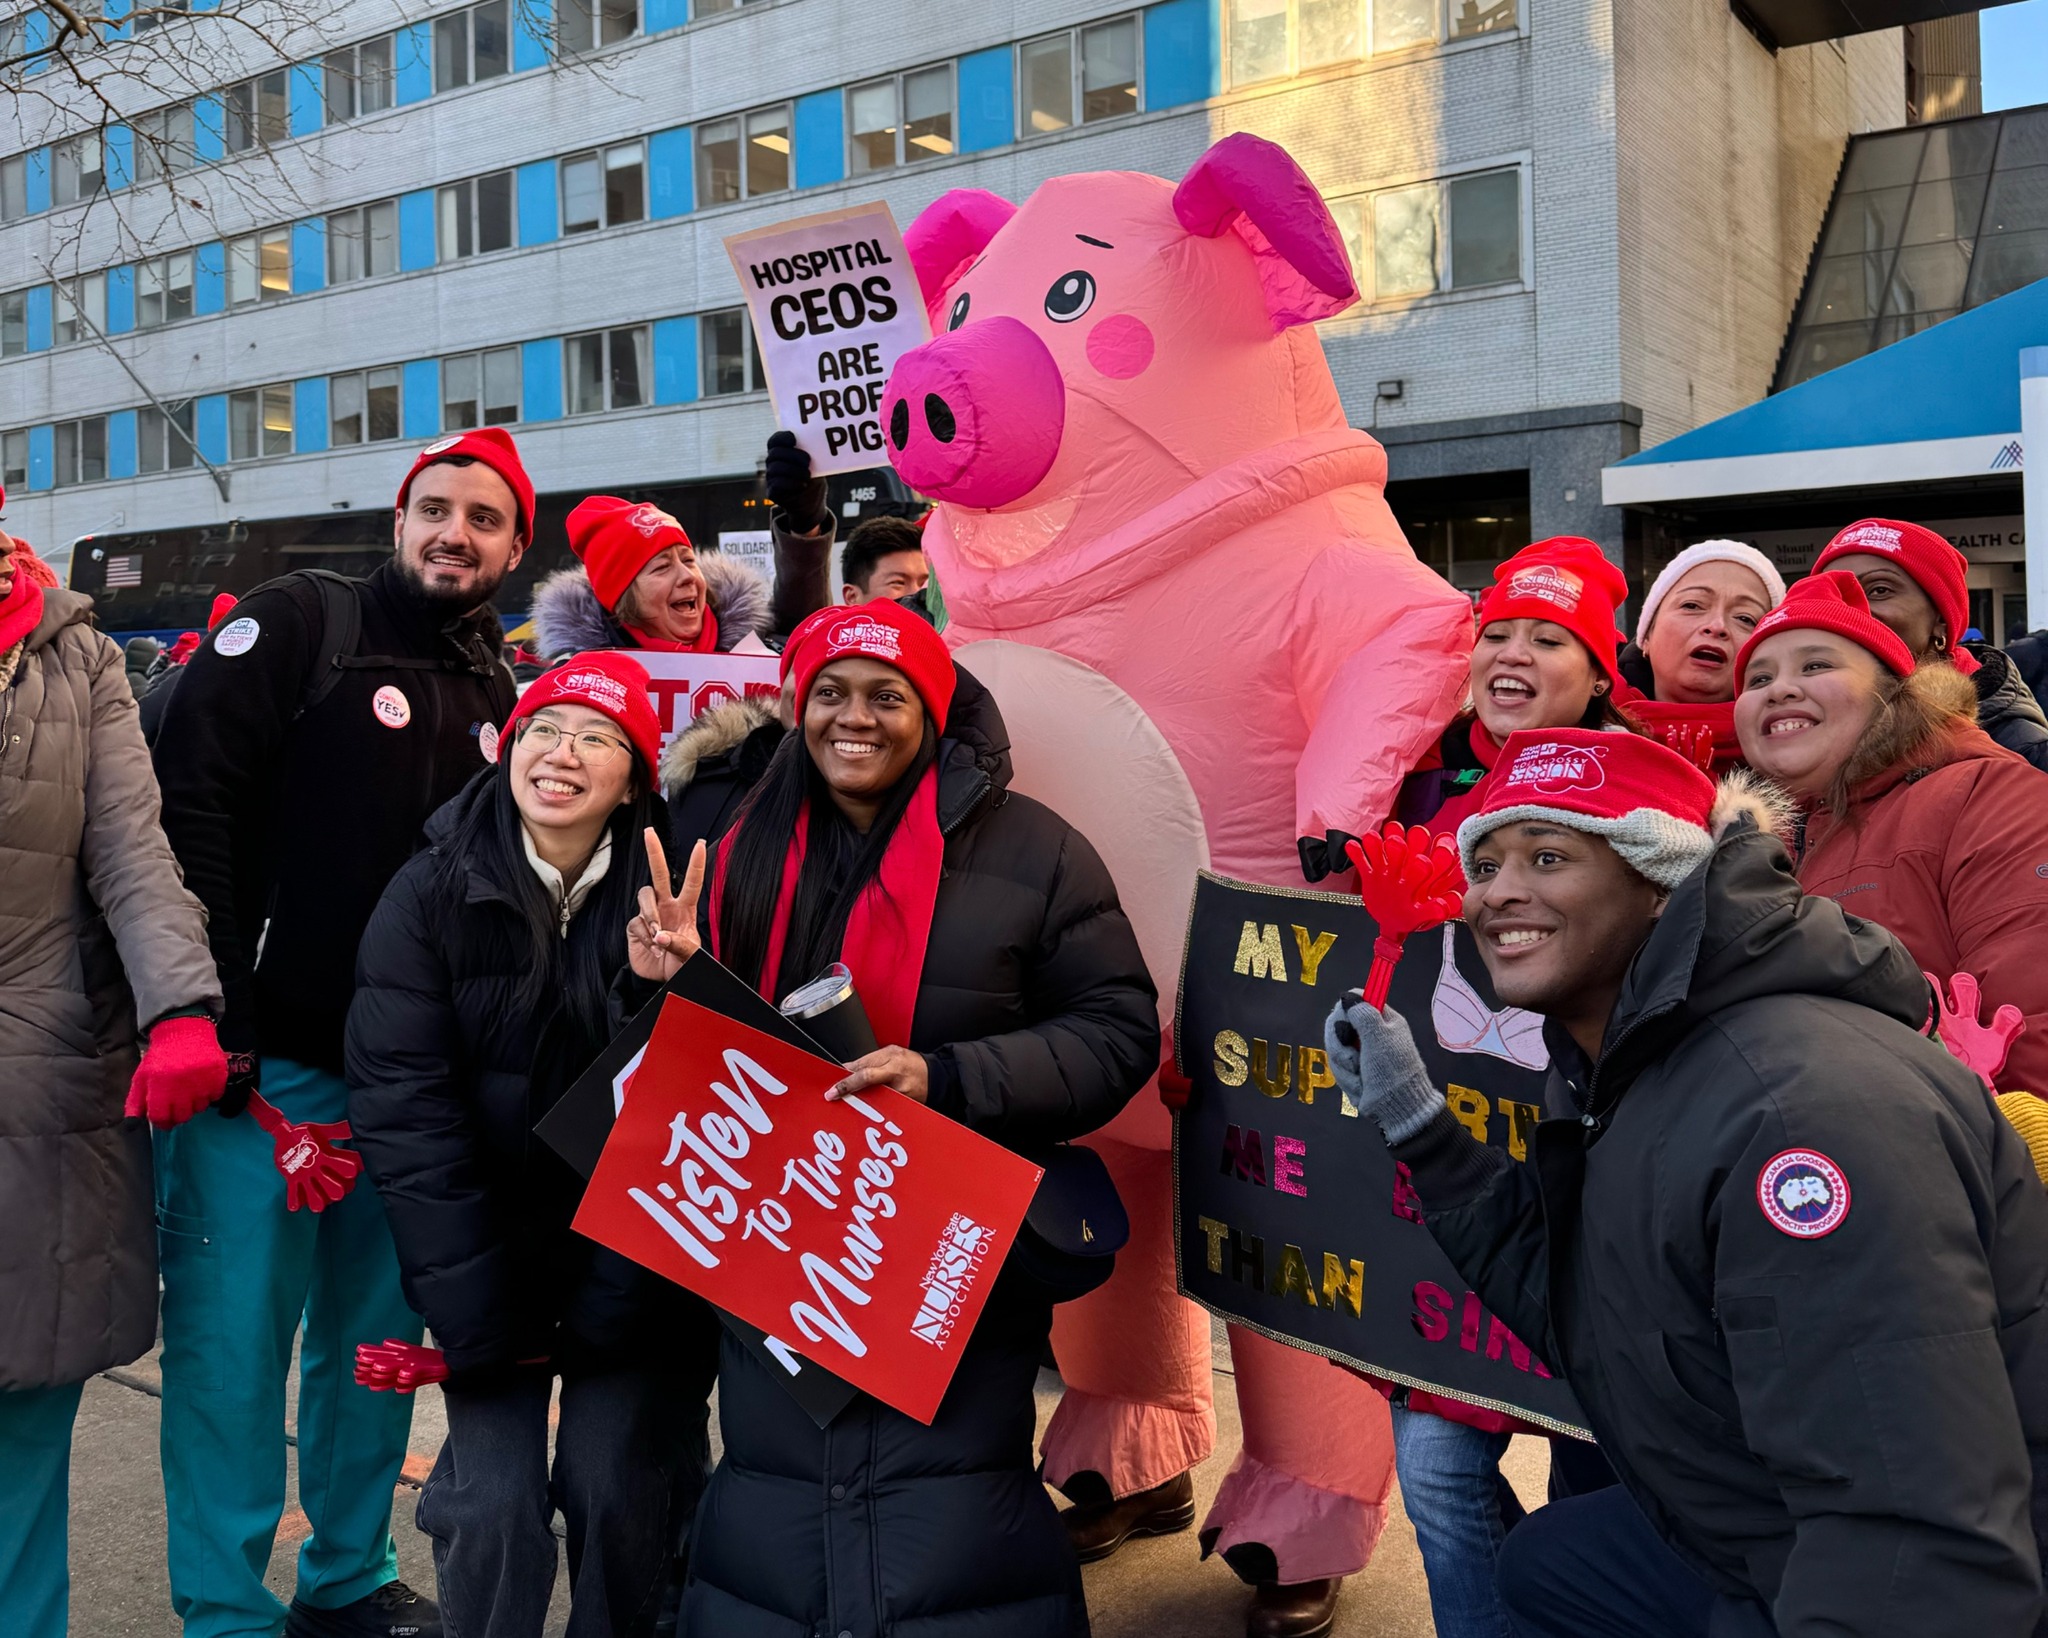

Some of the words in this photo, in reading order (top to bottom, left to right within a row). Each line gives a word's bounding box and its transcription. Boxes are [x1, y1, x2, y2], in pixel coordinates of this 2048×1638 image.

[750, 239, 892, 289] HOSPITAL
[770, 276, 898, 340] CEOS
[818, 343, 883, 383] ARE
[798, 379, 888, 424] PROF
[825, 420, 887, 456] PIG
[850, 486, 876, 501] 1465
[724, 541, 773, 555] SOLIDARIT
[1776, 543, 1814, 554] Mount
[1947, 533, 2001, 548] EALTH
[1776, 553, 1807, 565] Sinai
[839, 627, 900, 643] NURSES
[567, 674, 628, 698] NURSES
[377, 699, 399, 717] YES
[1233, 920, 1338, 986] MY
[1213, 1029, 1541, 1164] SUPRT
[1220, 1123, 1308, 1198] ME
[1766, 1156, 1794, 1181] CANADA
[1795, 1155, 1828, 1170] GOOSE
[1777, 1216, 1808, 1232] ARCTIC
[1808, 1205, 1840, 1232] PROGRAM
[919, 1265, 939, 1291] New
[930, 1239, 950, 1263] York
[942, 1211, 962, 1240] State
[1199, 1214, 1364, 1320] THAN
[910, 1214, 983, 1345] NURSES
